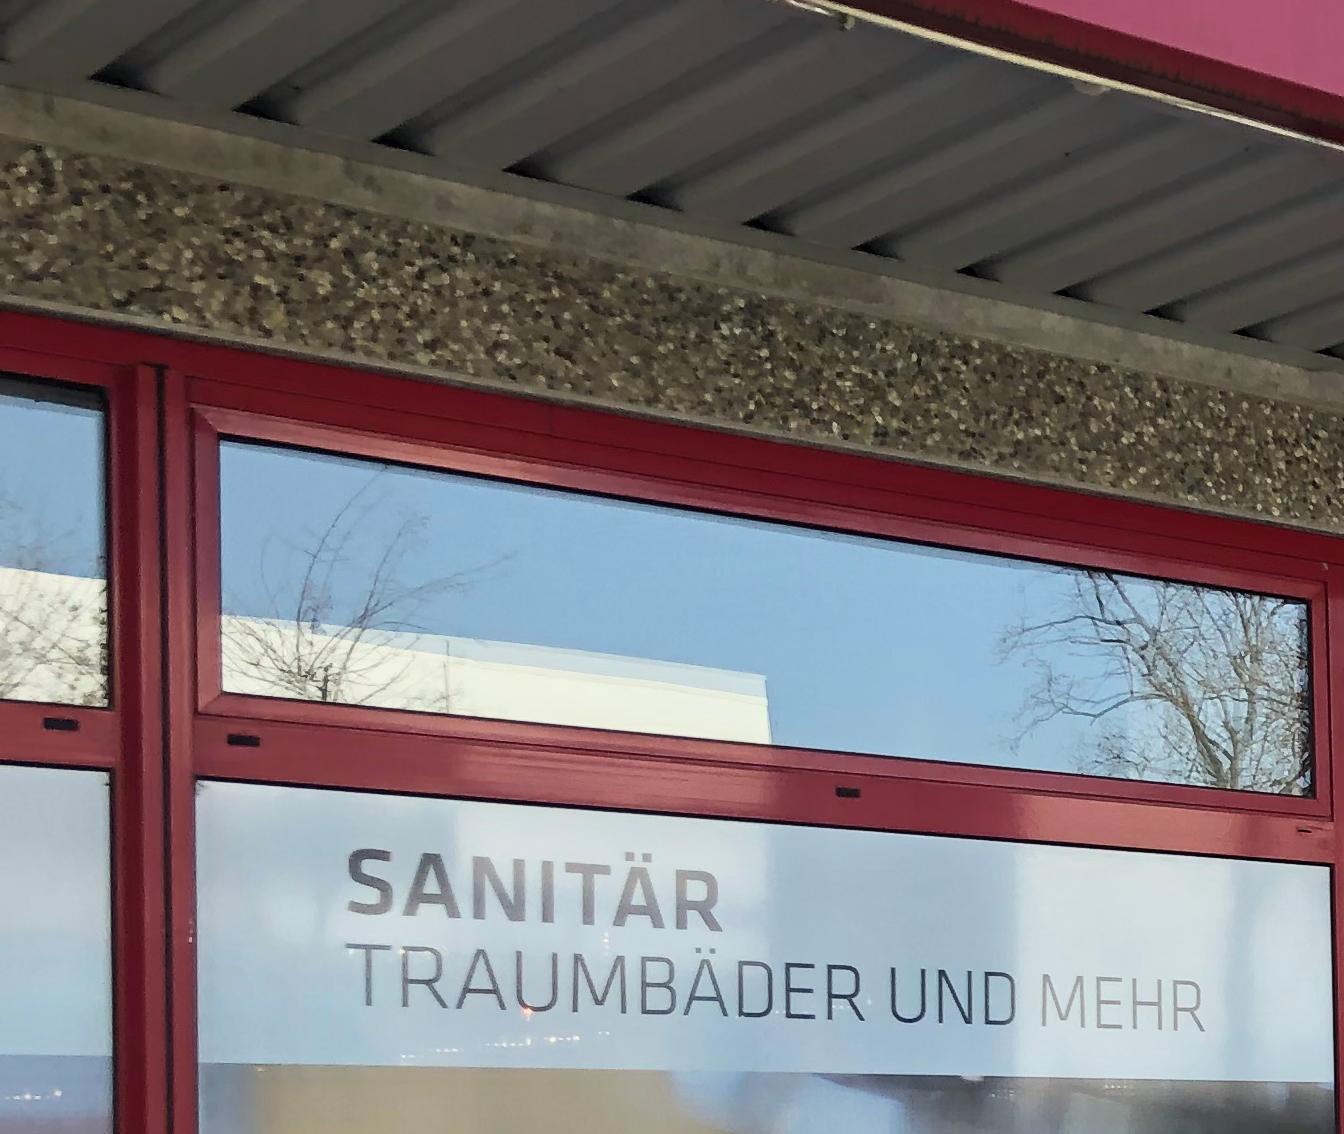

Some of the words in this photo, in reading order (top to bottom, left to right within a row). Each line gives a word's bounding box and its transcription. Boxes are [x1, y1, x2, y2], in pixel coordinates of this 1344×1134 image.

[347, 847, 723, 931] SANITÄR
[345, 943, 865, 1024] TRAUMBÄDER
[890, 966, 1016, 1026] UND
[1041, 975, 1206, 1033] MEHR
